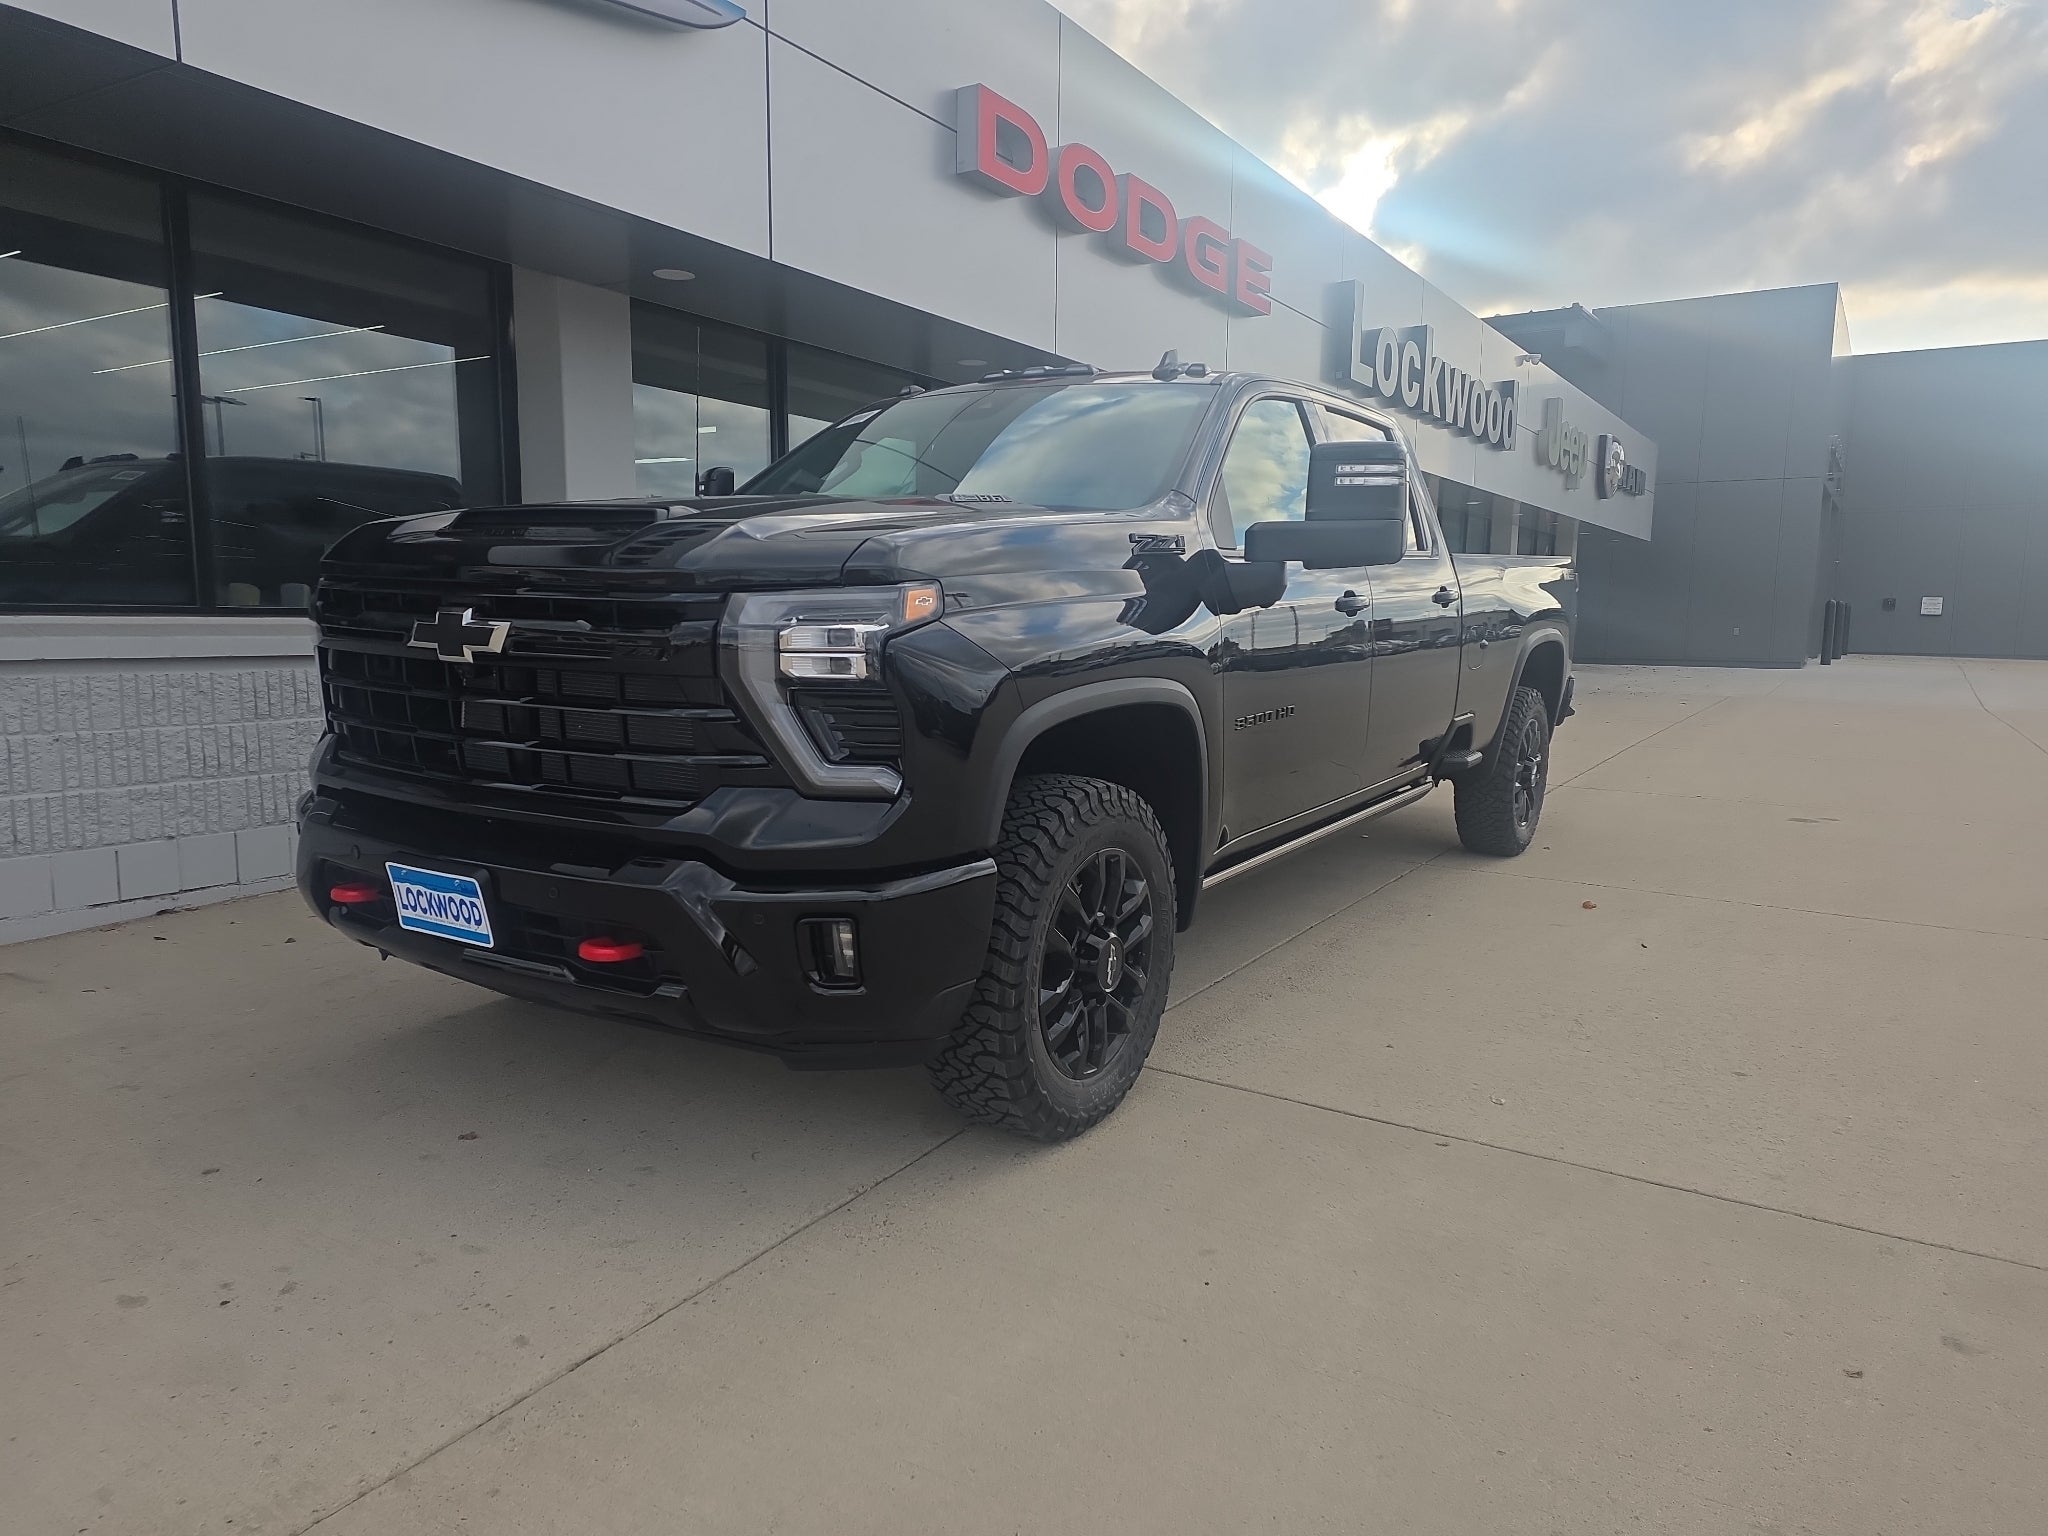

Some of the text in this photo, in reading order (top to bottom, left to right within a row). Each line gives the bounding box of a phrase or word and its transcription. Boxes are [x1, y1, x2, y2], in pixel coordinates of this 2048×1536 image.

[977, 83, 1273, 316] DODGE
[1546, 397, 1588, 482] Jeep
[1129, 533, 1186, 555] Z71
[396, 885, 482, 926] LOCKWOOD
